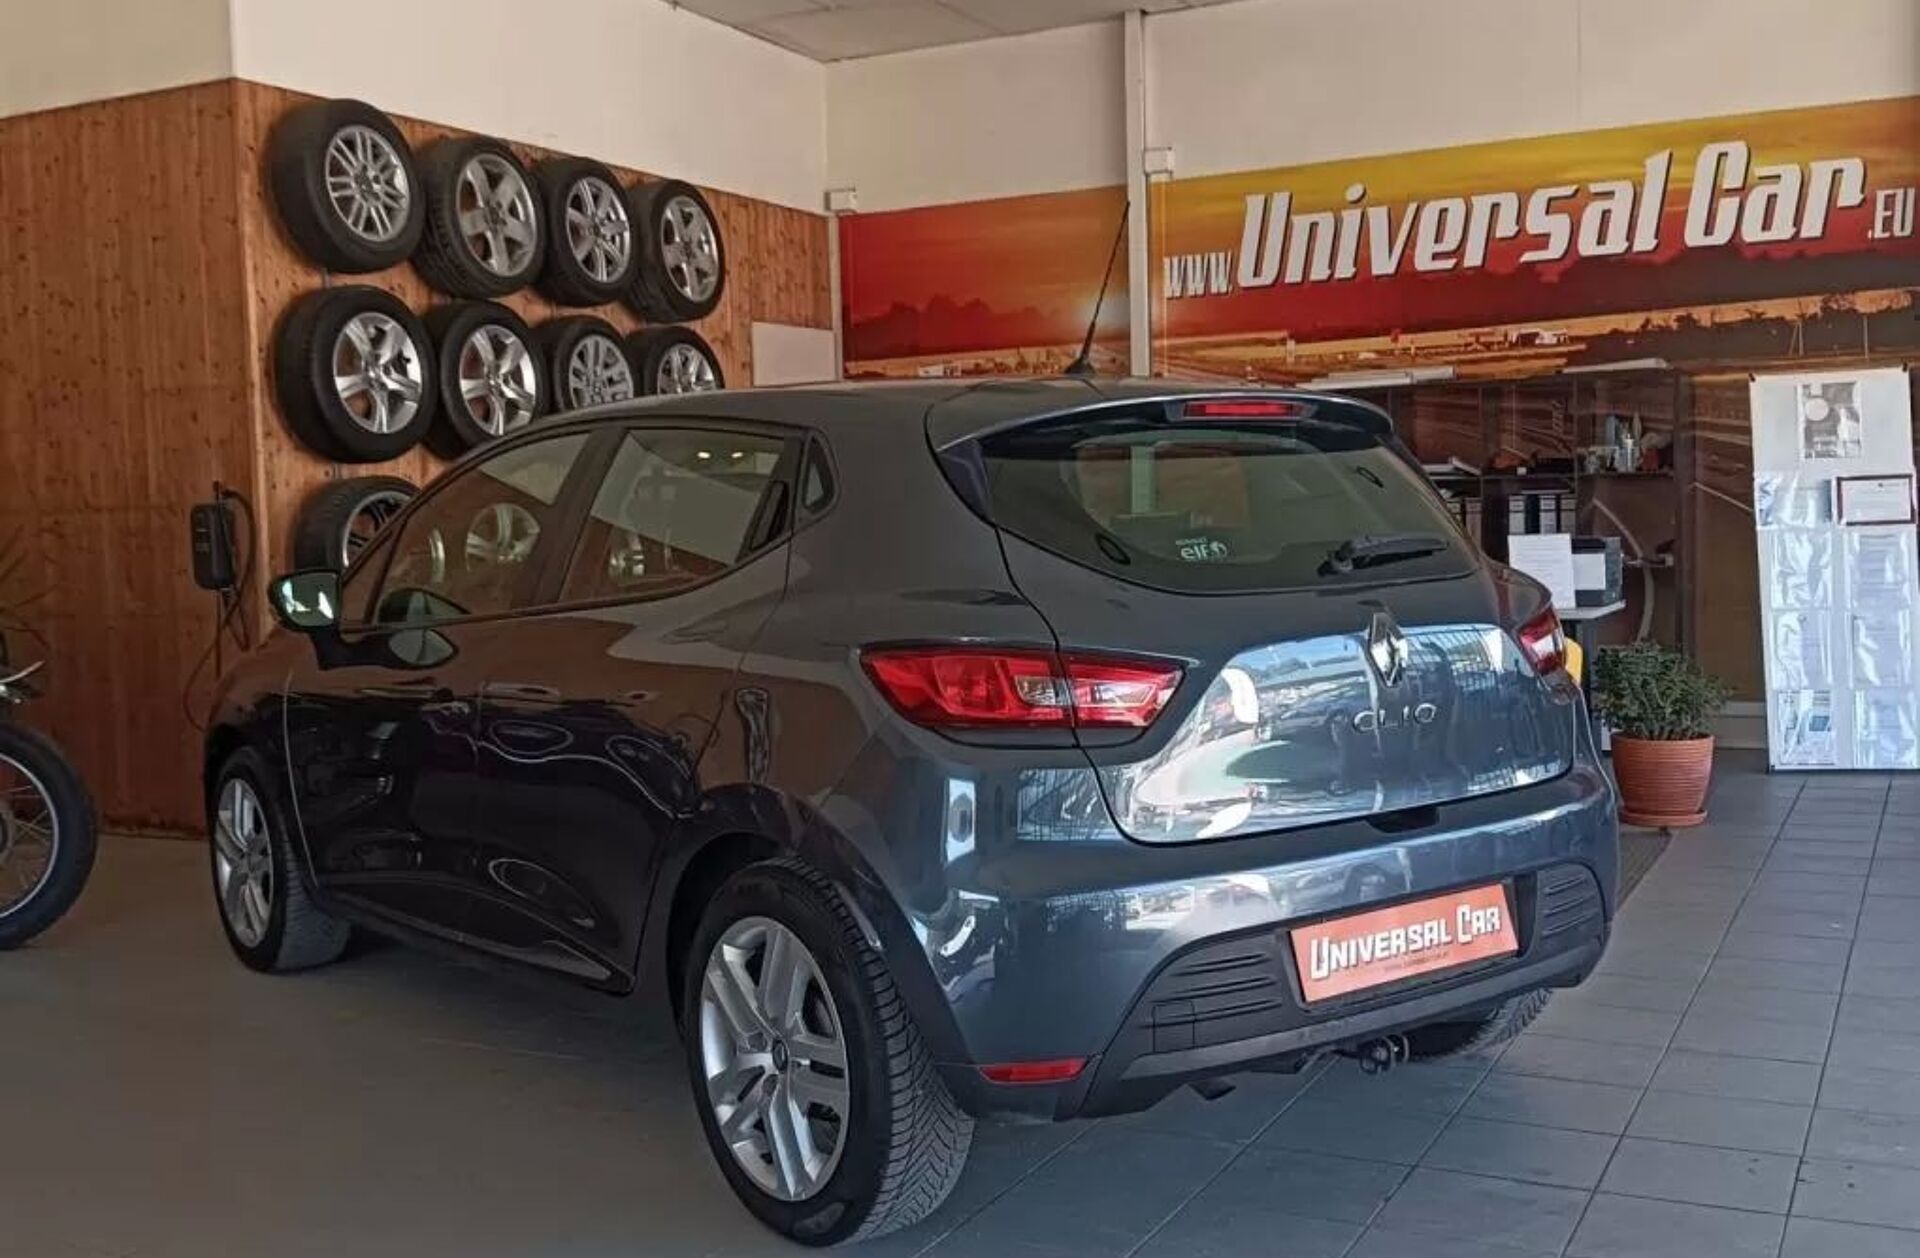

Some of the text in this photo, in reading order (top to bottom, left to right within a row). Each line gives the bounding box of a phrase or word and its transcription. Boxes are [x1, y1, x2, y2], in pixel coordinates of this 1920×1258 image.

[1237, 147, 1673, 289] Universal
[1684, 140, 1866, 248] Car
[1353, 702, 1438, 732] CLIO
